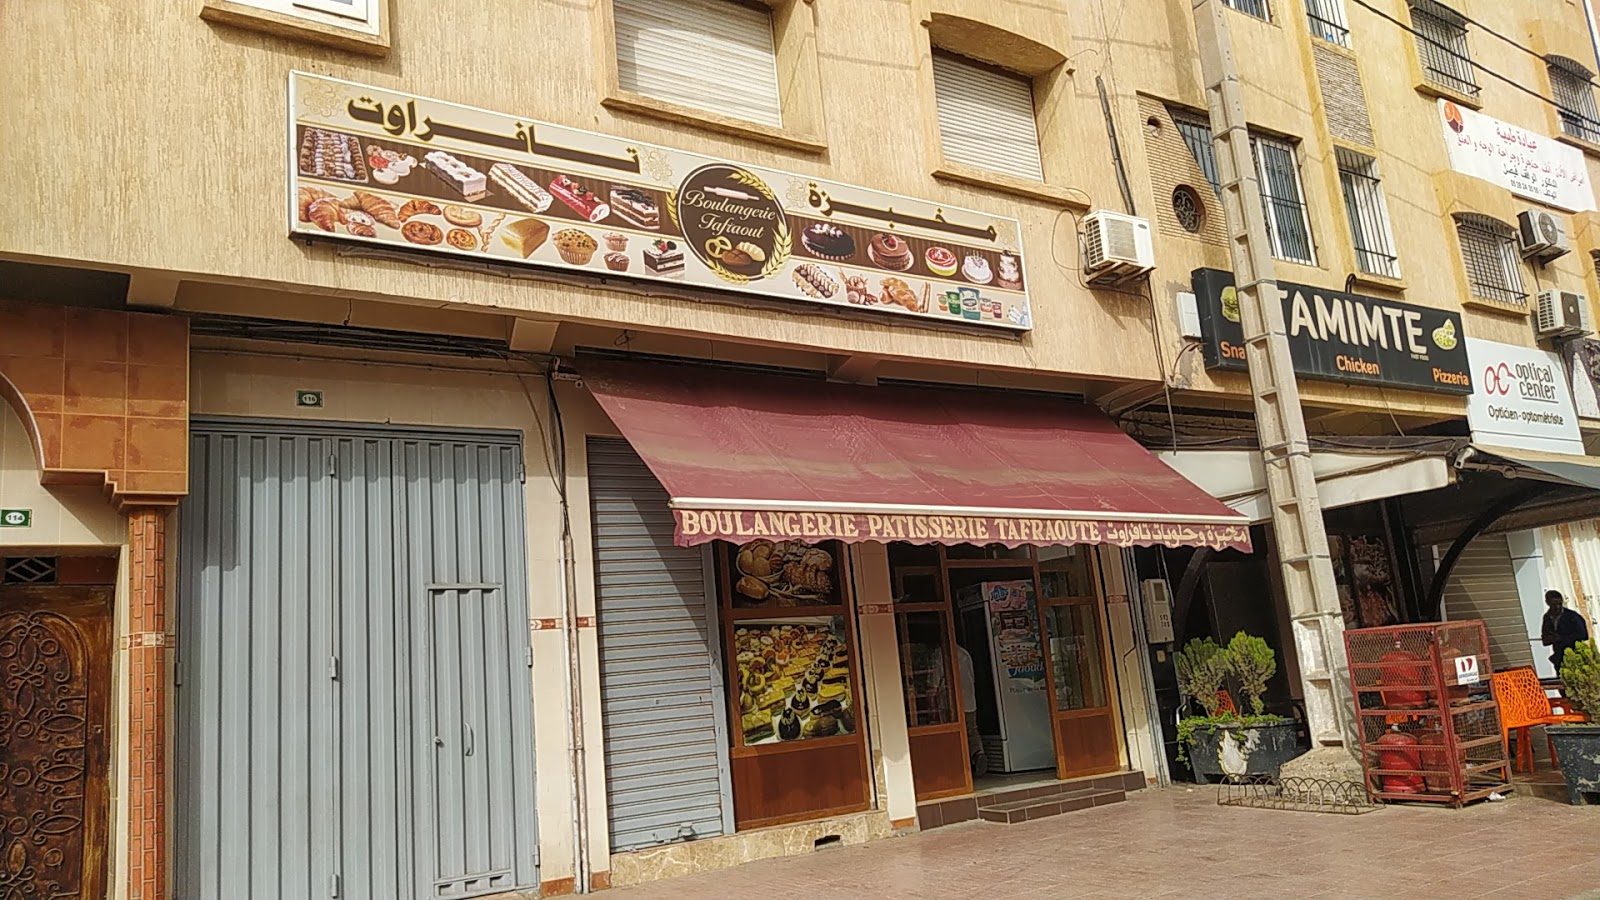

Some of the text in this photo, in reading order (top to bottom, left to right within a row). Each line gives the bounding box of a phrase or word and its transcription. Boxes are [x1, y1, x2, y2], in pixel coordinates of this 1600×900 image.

[346, 96, 998, 243] مخبزة تافراوت
[682, 189, 776, 221] Boulangerie
[698, 213, 765, 239] Tafraout
[1220, 341, 1469, 386] Sna Chicken Pizzeria
[1515, 362, 1554, 384] optical
[1519, 381, 1556, 400] center
[680, 509, 1100, 542] BOULANGERIE PATISSERIE TAFRAOUTE
